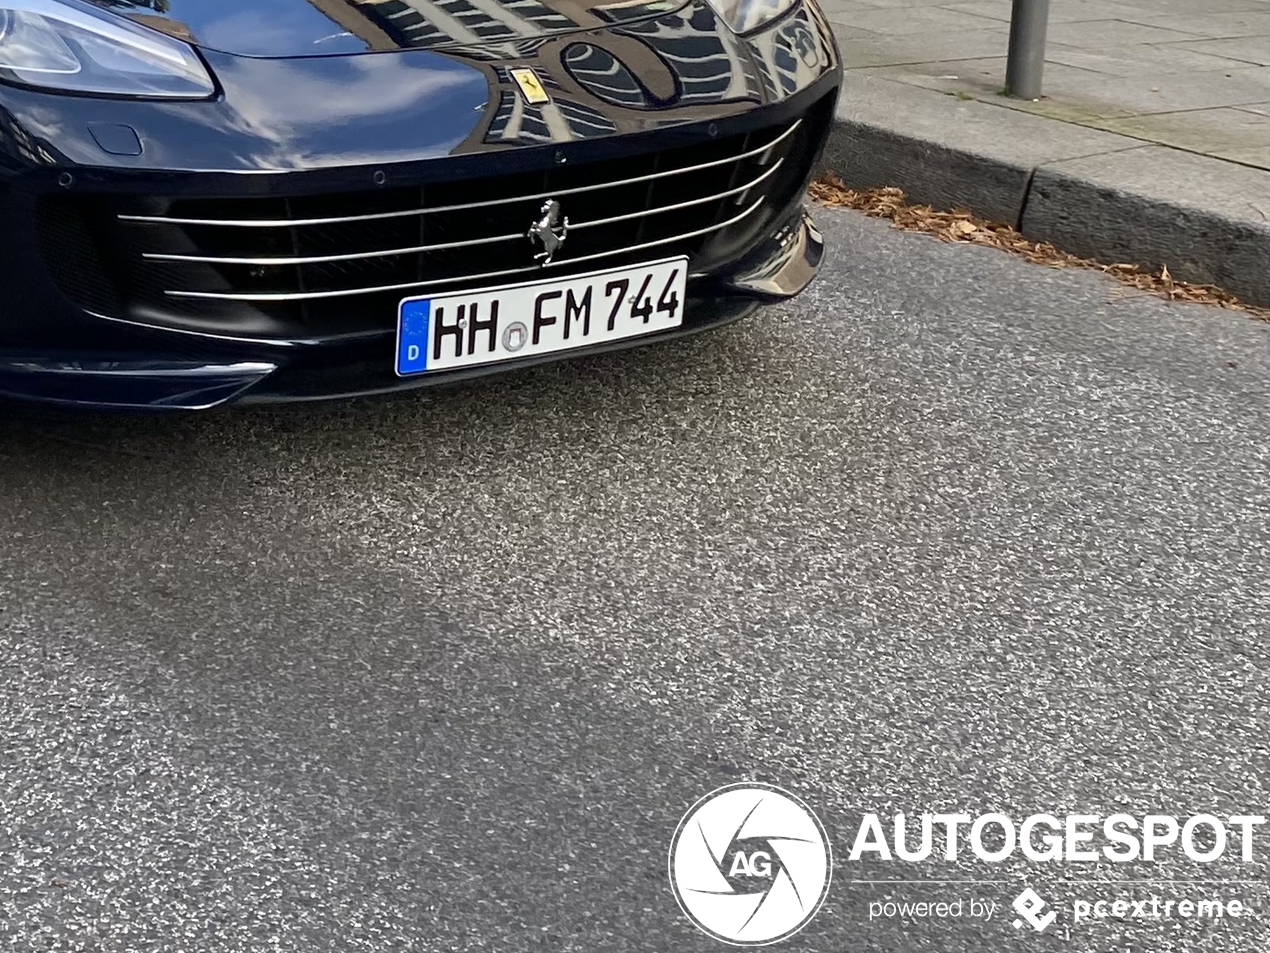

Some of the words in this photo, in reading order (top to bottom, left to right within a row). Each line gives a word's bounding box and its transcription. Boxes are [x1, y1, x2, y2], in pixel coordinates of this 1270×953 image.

[433, 299, 499, 360] HH
[532, 285, 593, 345] FM
[605, 268, 679, 331] 744
[408, 344, 420, 360] D
